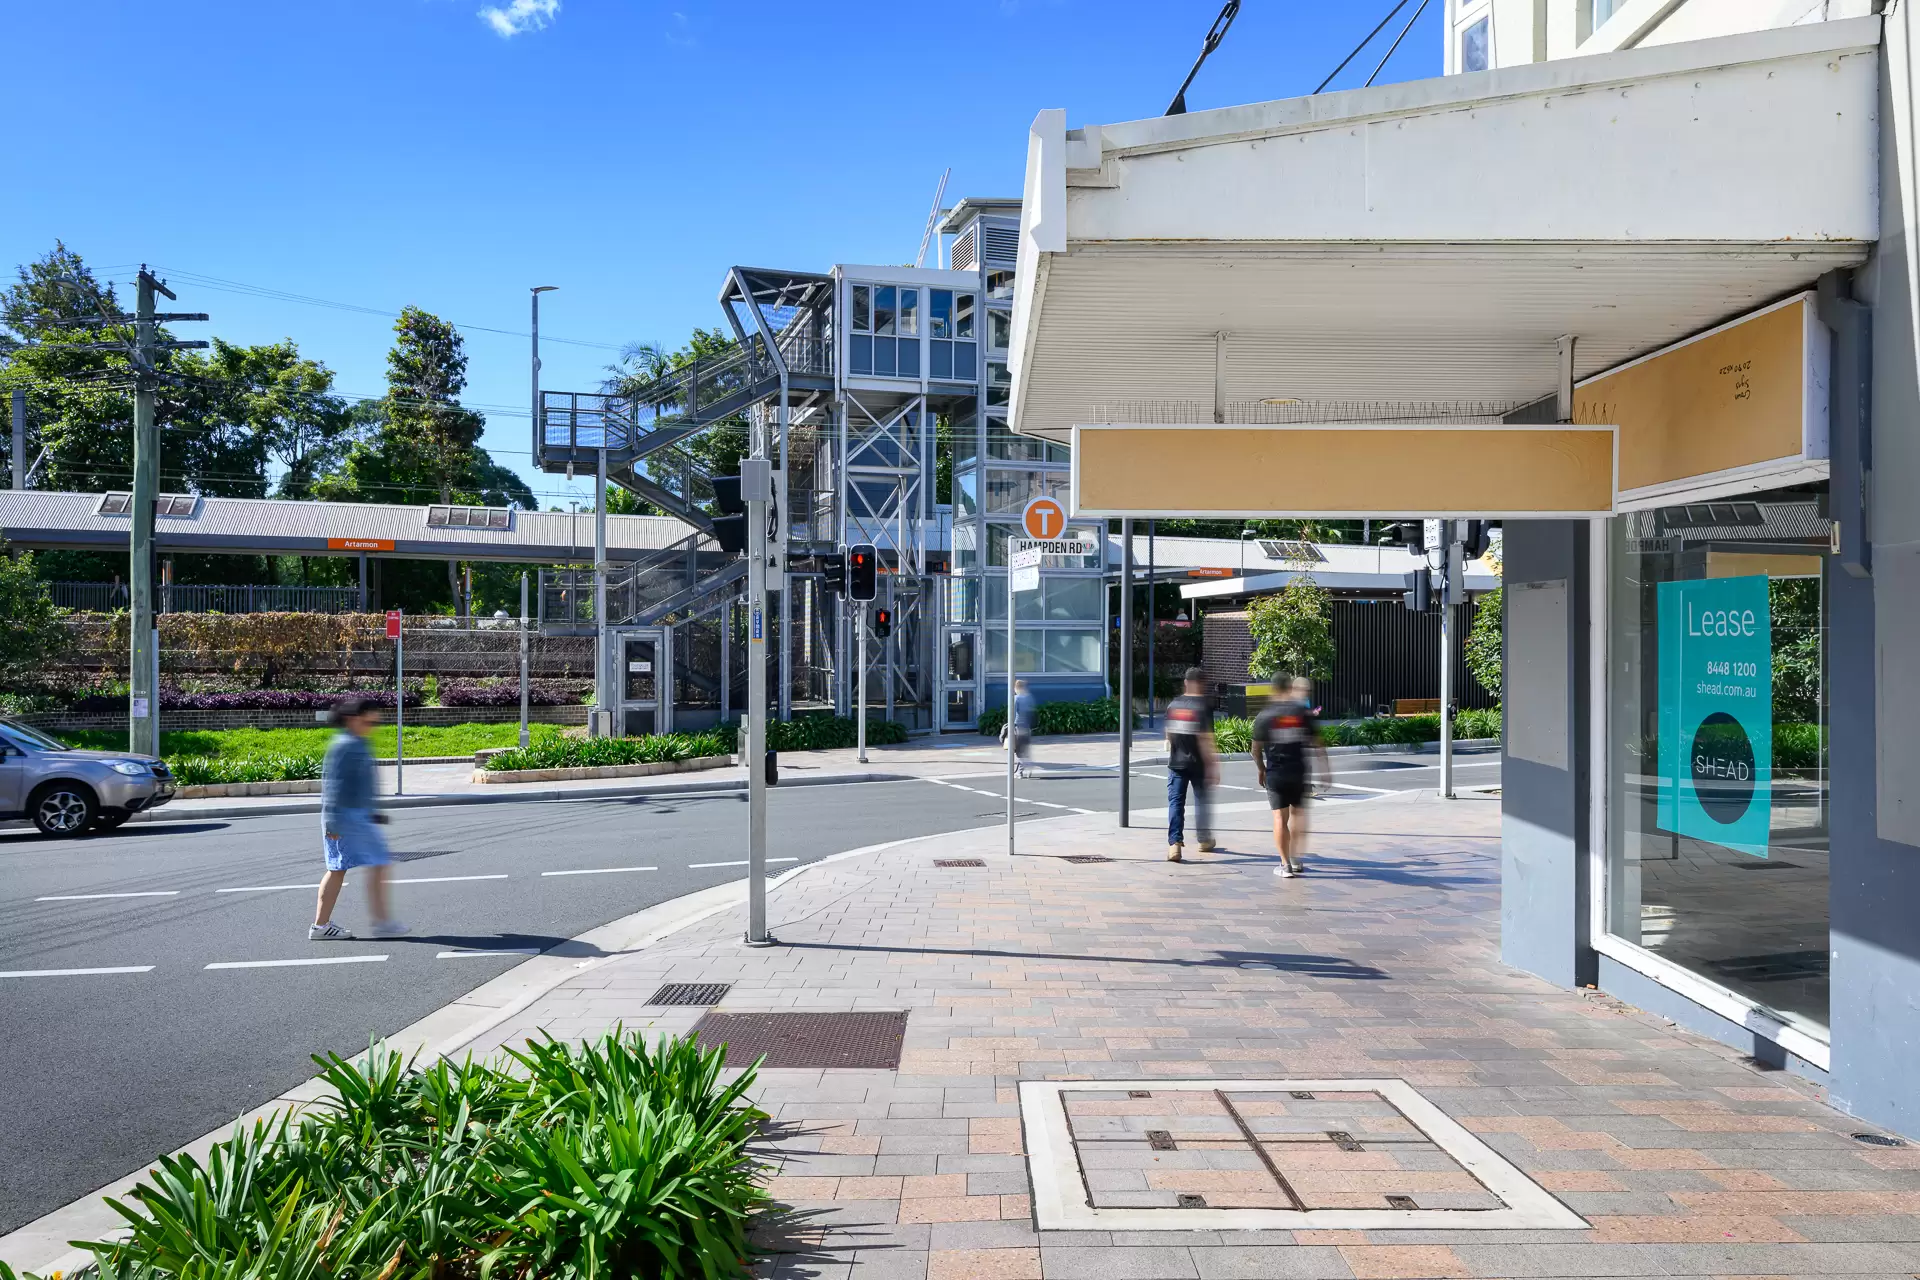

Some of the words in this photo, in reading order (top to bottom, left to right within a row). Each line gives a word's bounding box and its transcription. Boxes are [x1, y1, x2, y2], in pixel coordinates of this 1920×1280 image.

[1035, 508, 1055, 535] T
[344, 540, 379, 548] Artarmon
[1069, 542, 1082, 554] RD
[1688, 601, 1755, 636] Lease
[1707, 661, 1730, 675] 8448
[1733, 662, 1757, 677] 1200
[1696, 680, 1757, 698] shead.com.au
[1696, 755, 1749, 781] SHEAD
